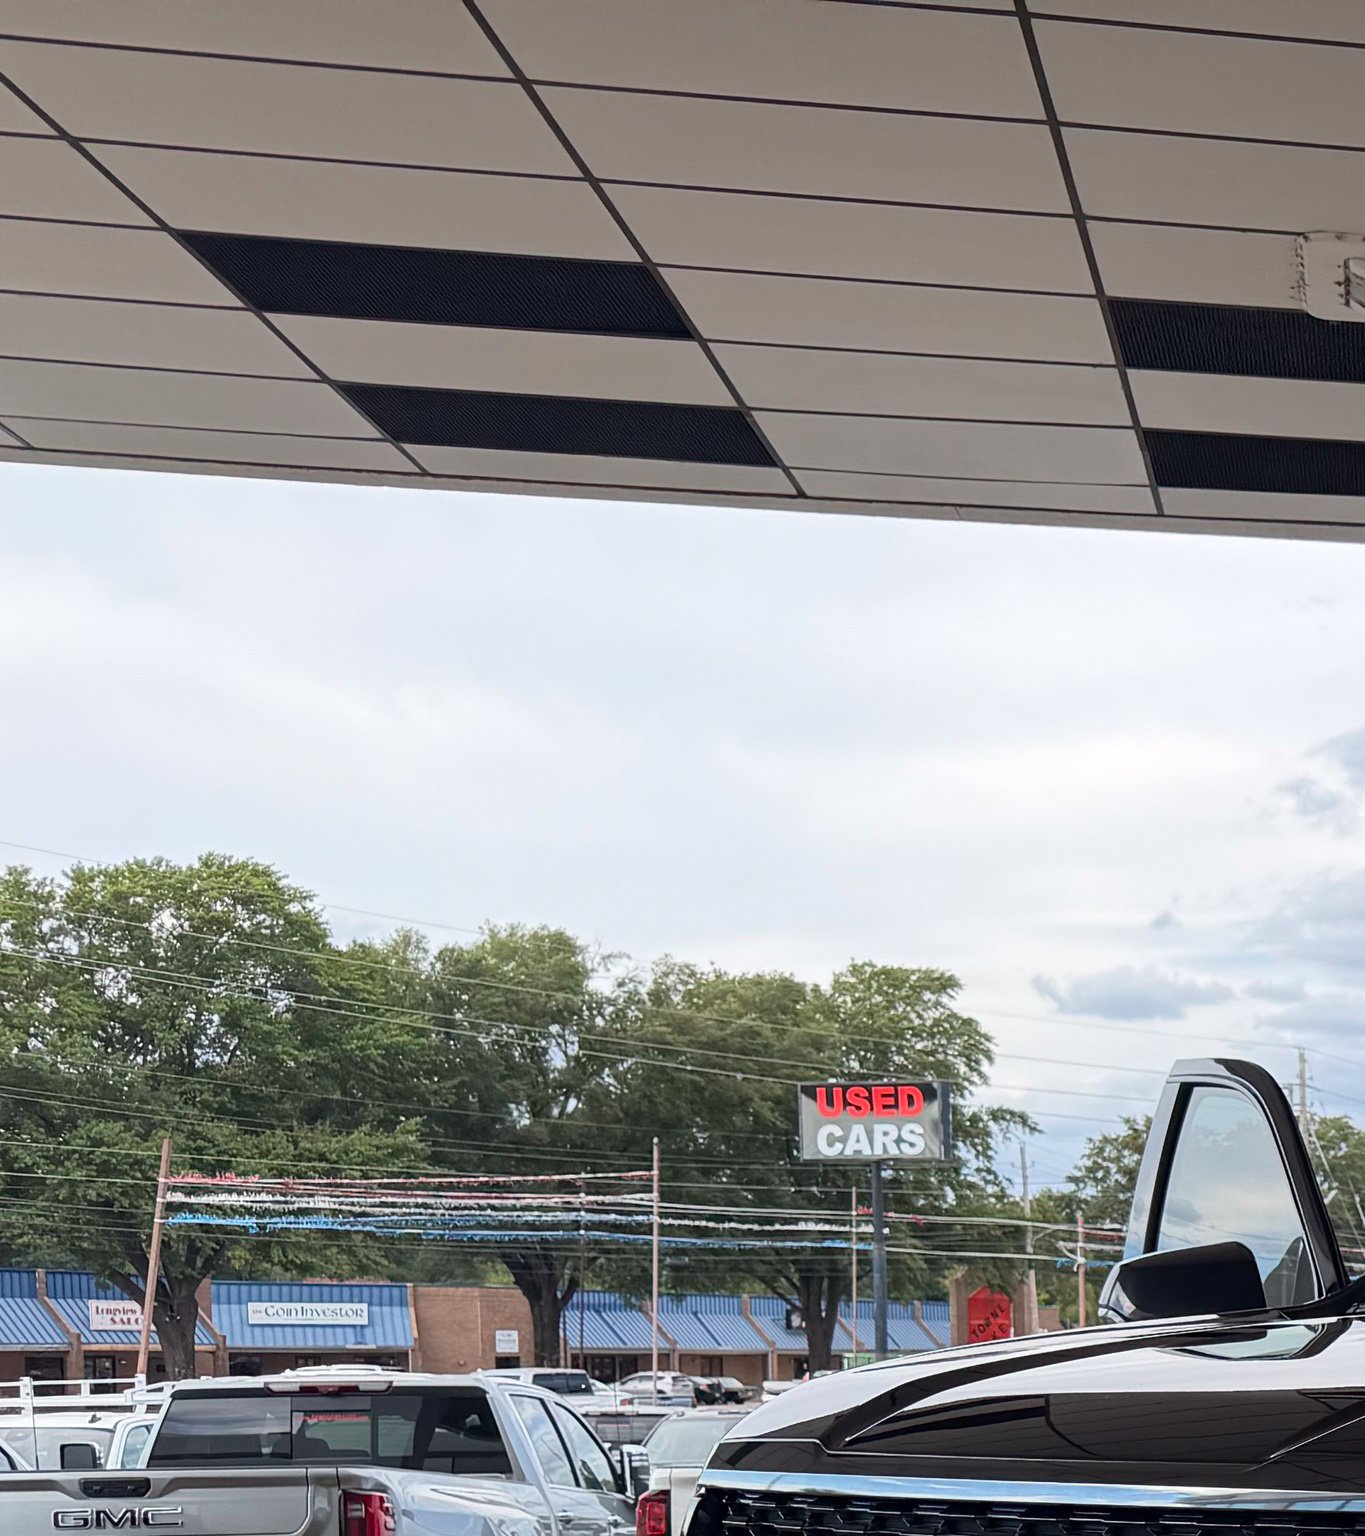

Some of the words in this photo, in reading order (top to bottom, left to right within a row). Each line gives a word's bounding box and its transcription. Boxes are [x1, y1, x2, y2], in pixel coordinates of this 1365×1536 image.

[816, 1086, 924, 1118] USED
[816, 1123, 926, 1157] CARS
[264, 1305, 298, 1317] Coin
[52, 1506, 183, 1529] GMC
